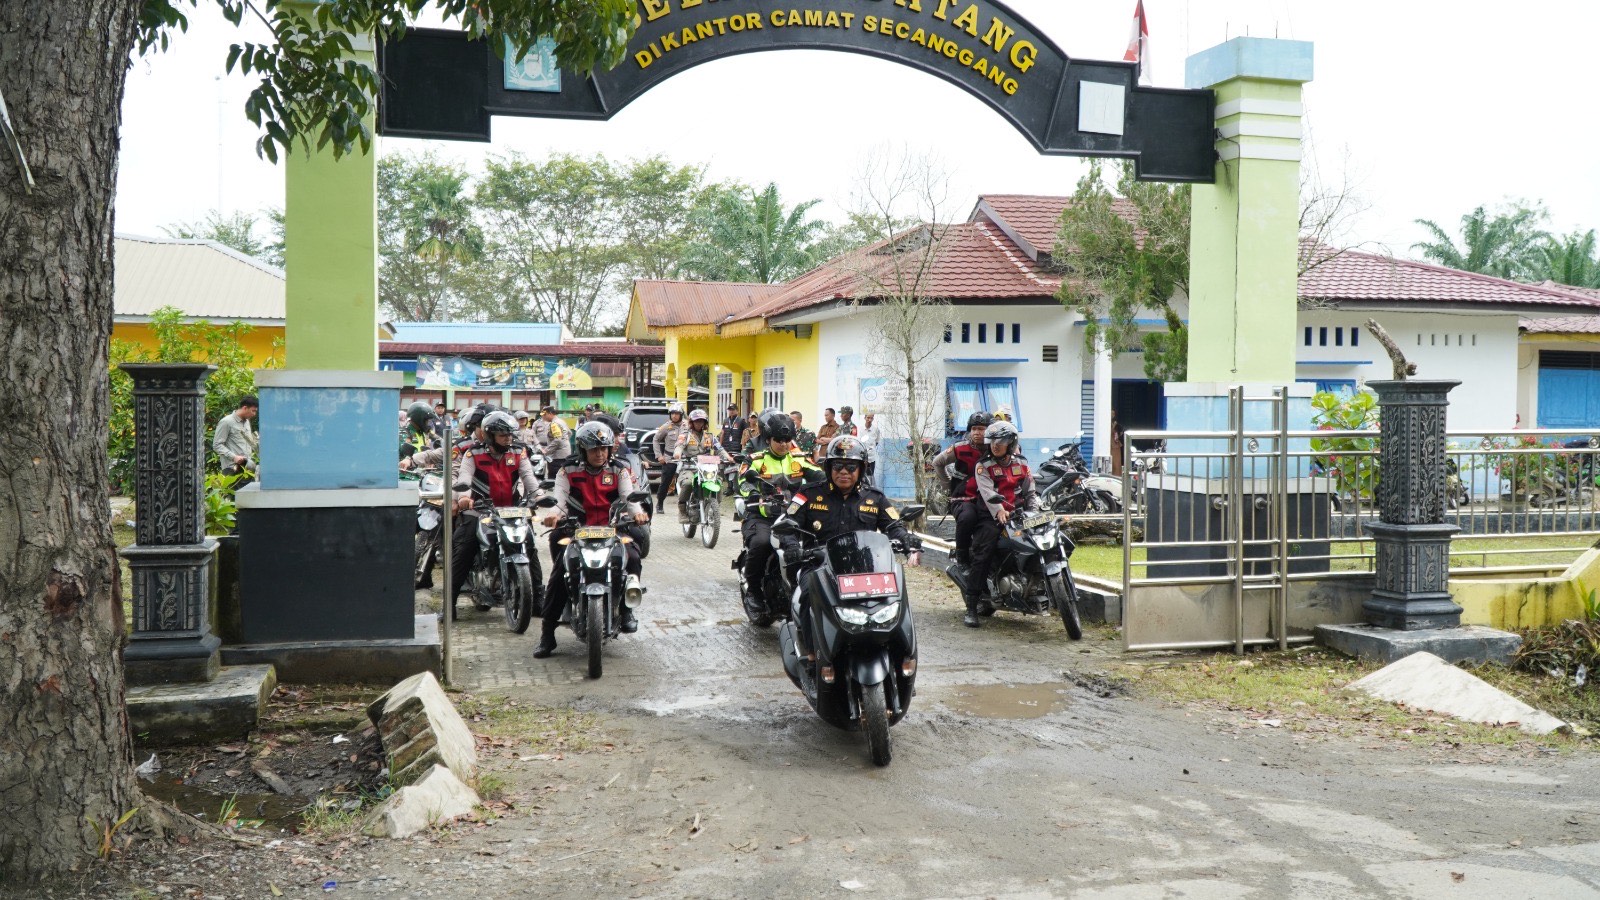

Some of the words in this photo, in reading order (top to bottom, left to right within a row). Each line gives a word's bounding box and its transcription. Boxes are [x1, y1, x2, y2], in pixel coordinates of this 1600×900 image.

[635, 42, 662, 69] DI
[661, 12, 763, 52] KANTOR
[770, 9, 855, 28] CAMAT
[863, 15, 1019, 96] SECANGGANG
[509, 357, 545, 367] Stunting
[809, 503, 829, 511] FAISAL
[859, 505, 879, 514] BUPATI
[843, 578, 855, 587] BK
[865, 576, 872, 586] 1
[883, 575, 890, 584] P
